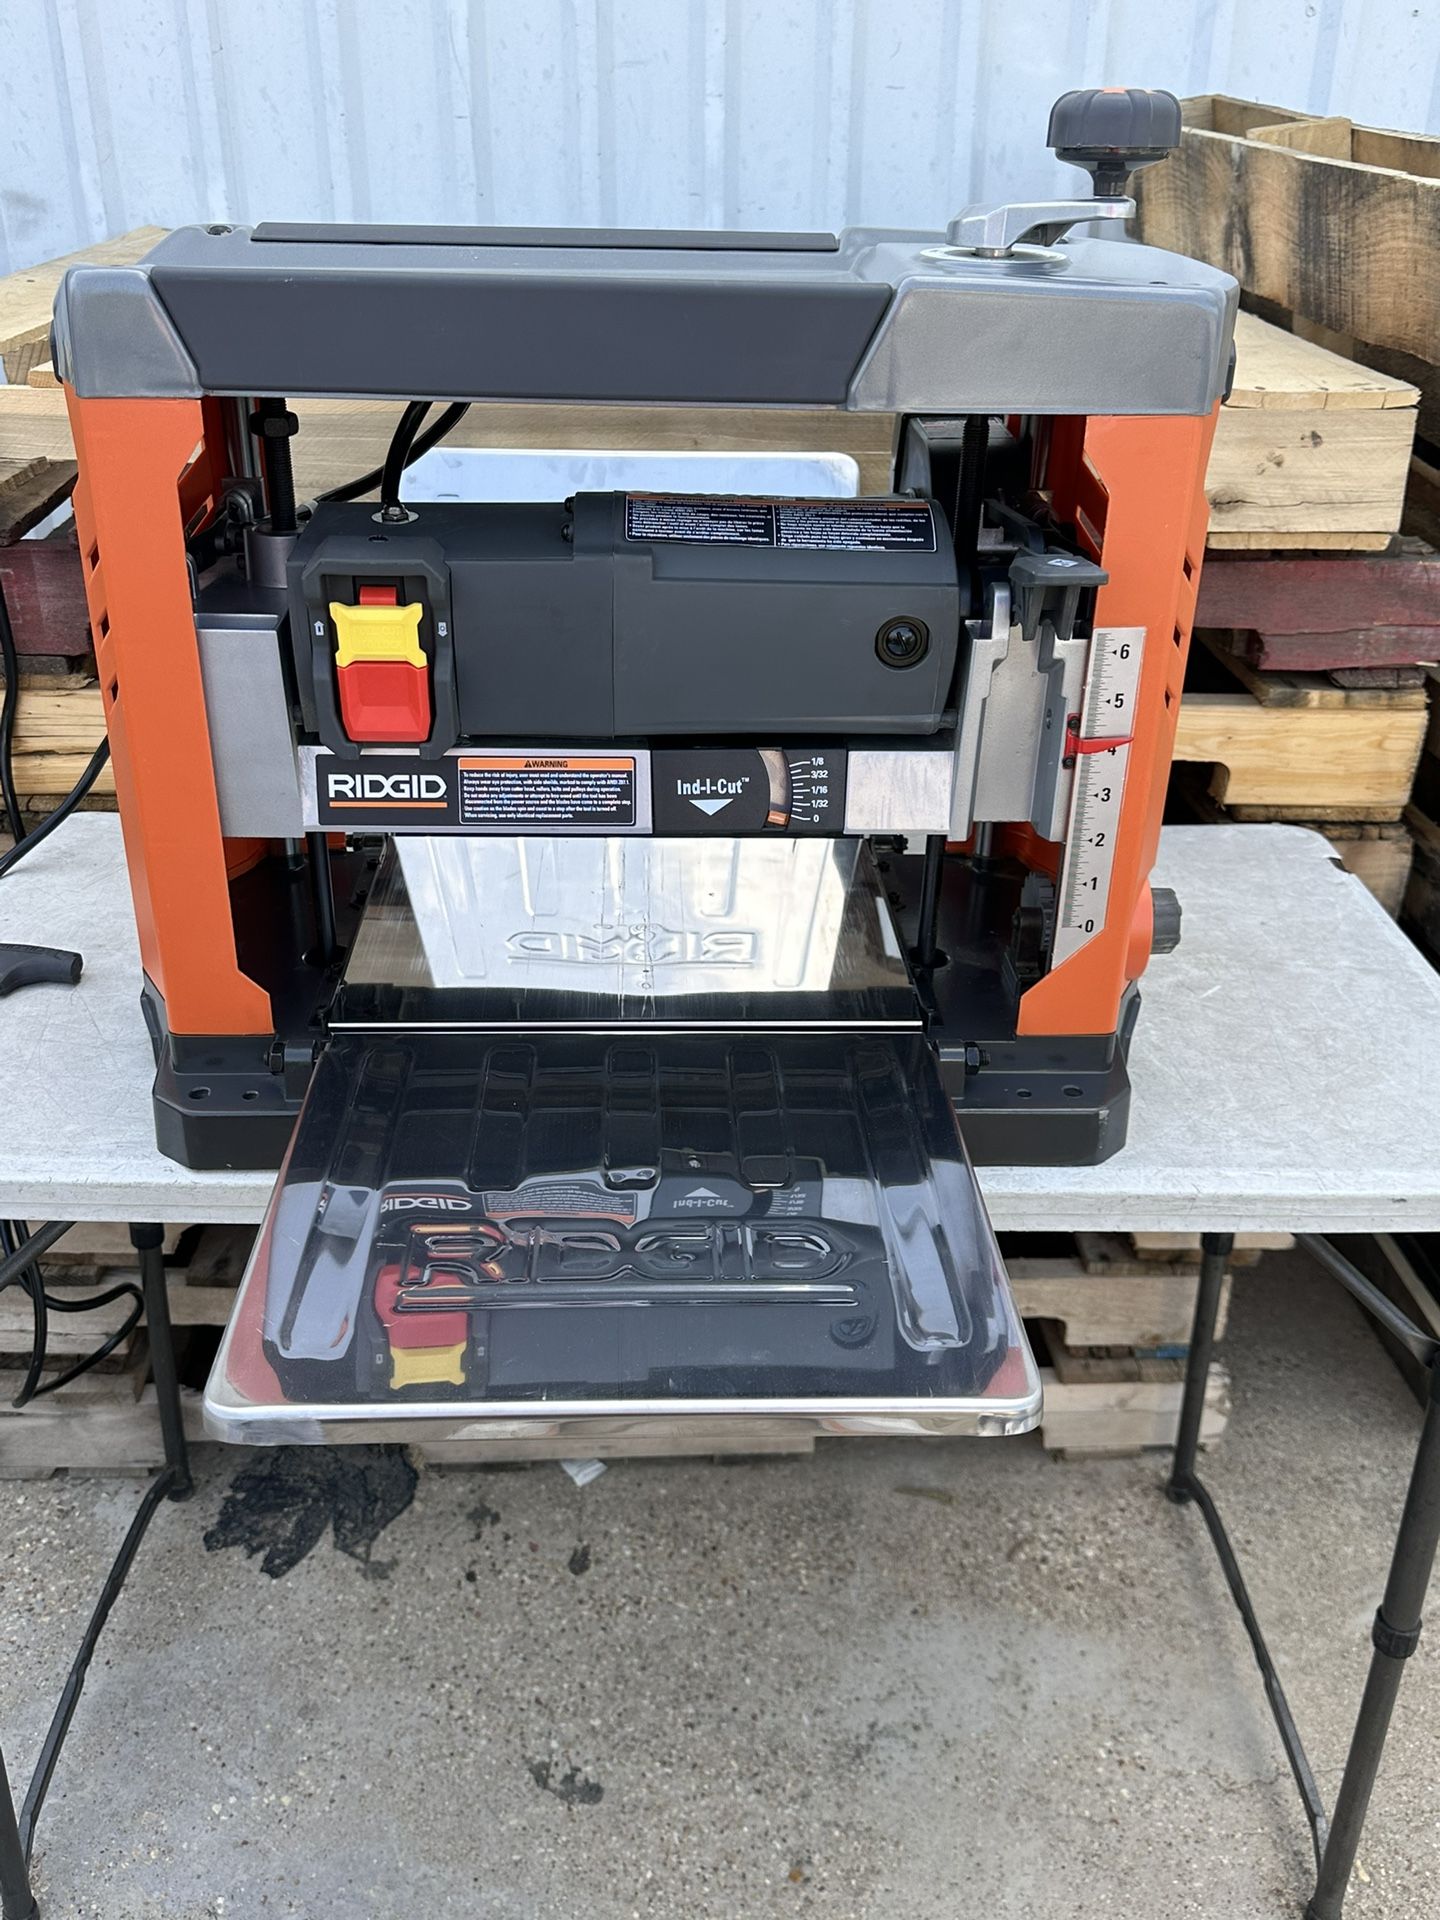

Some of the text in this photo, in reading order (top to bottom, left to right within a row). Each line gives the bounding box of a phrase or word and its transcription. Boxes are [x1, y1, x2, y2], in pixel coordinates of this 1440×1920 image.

[1120, 644, 1130, 660] 6
[1114, 693, 1124, 708] 5
[811, 758, 824, 766] 1/8
[811, 770, 828, 778] 3/32
[328, 774, 447, 798] RIDGID
[811, 786, 828, 794] 1/16
[1101, 788, 1111, 802] 3
[811, 800, 828, 808] 1/32
[813, 815, 820, 823] 0
[1094, 832, 1105, 847] 2
[1090, 876, 1098, 890] 1
[1085, 920, 1094, 933] 0
